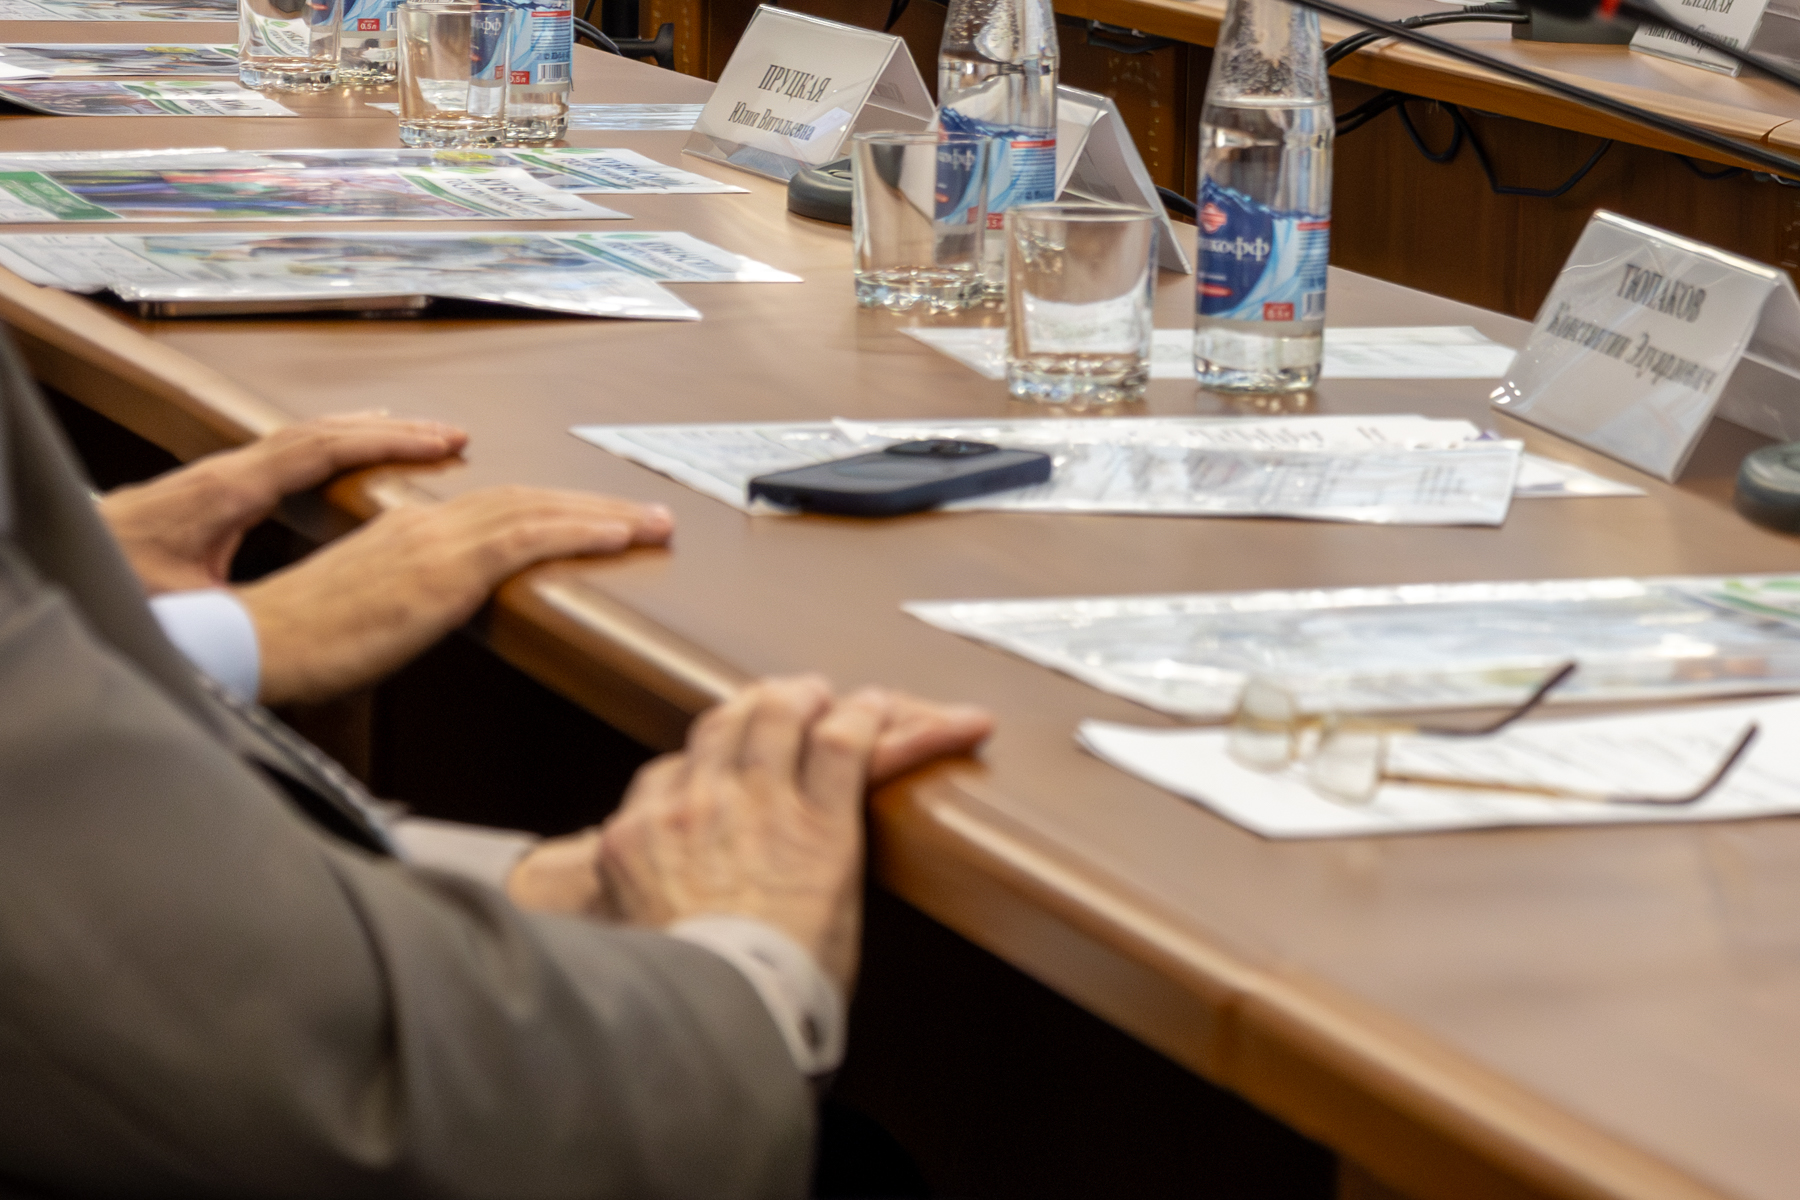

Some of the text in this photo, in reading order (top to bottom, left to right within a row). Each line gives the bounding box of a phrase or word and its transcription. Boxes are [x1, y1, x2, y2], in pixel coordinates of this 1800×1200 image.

[758, 64, 832, 103] ПРУЦКАЯ
[728, 101, 816, 141] Юлия Витальевна
